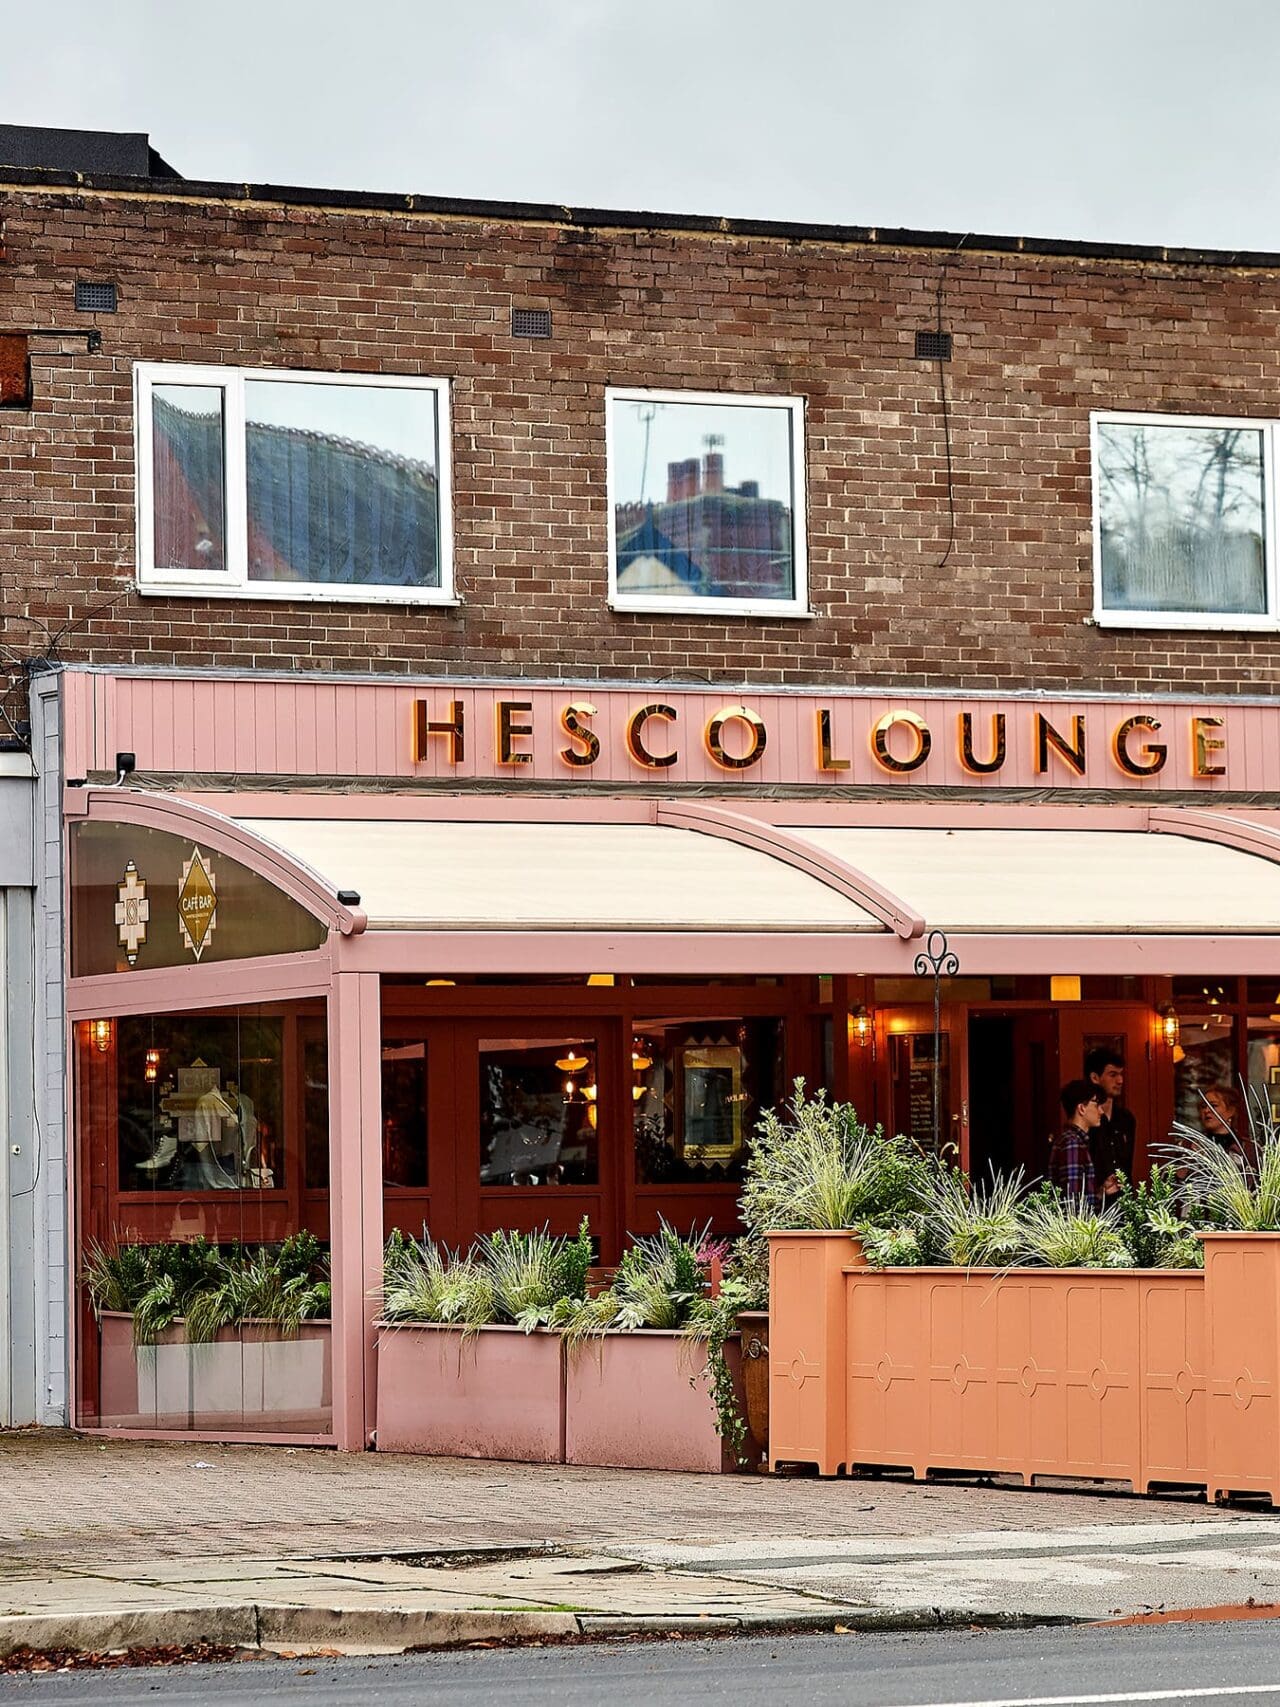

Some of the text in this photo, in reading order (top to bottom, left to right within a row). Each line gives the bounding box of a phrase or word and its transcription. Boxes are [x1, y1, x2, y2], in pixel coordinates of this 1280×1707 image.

[411, 699, 1227, 777] HESCO LOUNGE
[199, 894, 213, 909] BAR
